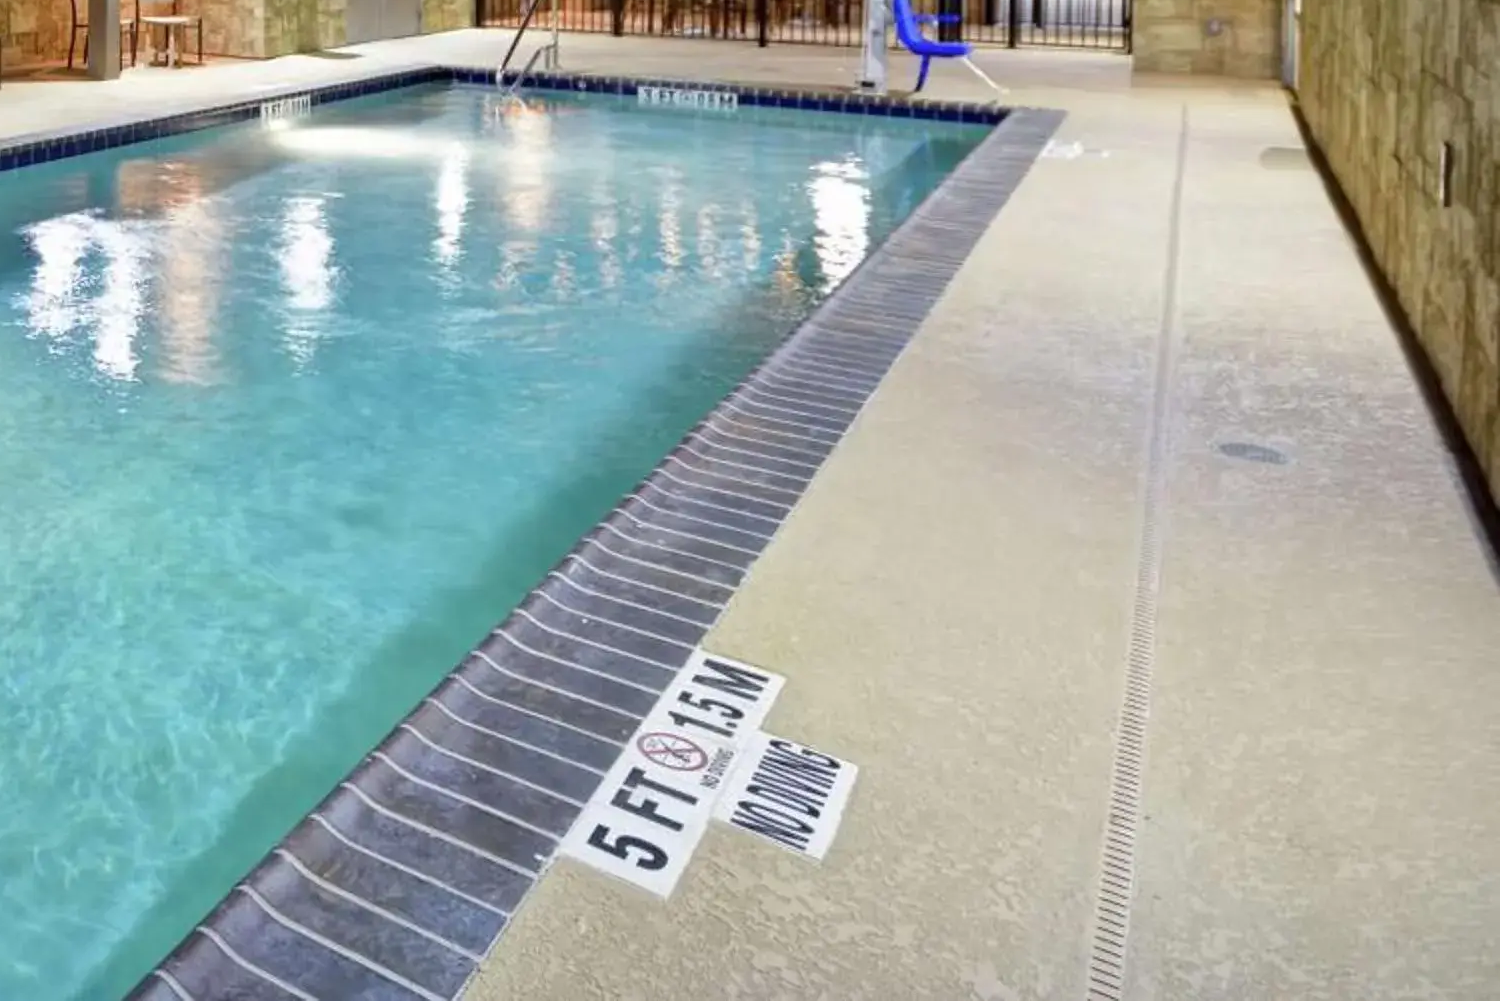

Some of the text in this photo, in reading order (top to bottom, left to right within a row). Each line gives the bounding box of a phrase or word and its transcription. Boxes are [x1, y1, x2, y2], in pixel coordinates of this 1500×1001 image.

[691, 658, 771, 702] M
[609, 766, 700, 833] FT
[729, 739, 842, 851] NO DIVING
[586, 822, 669, 871] 5
